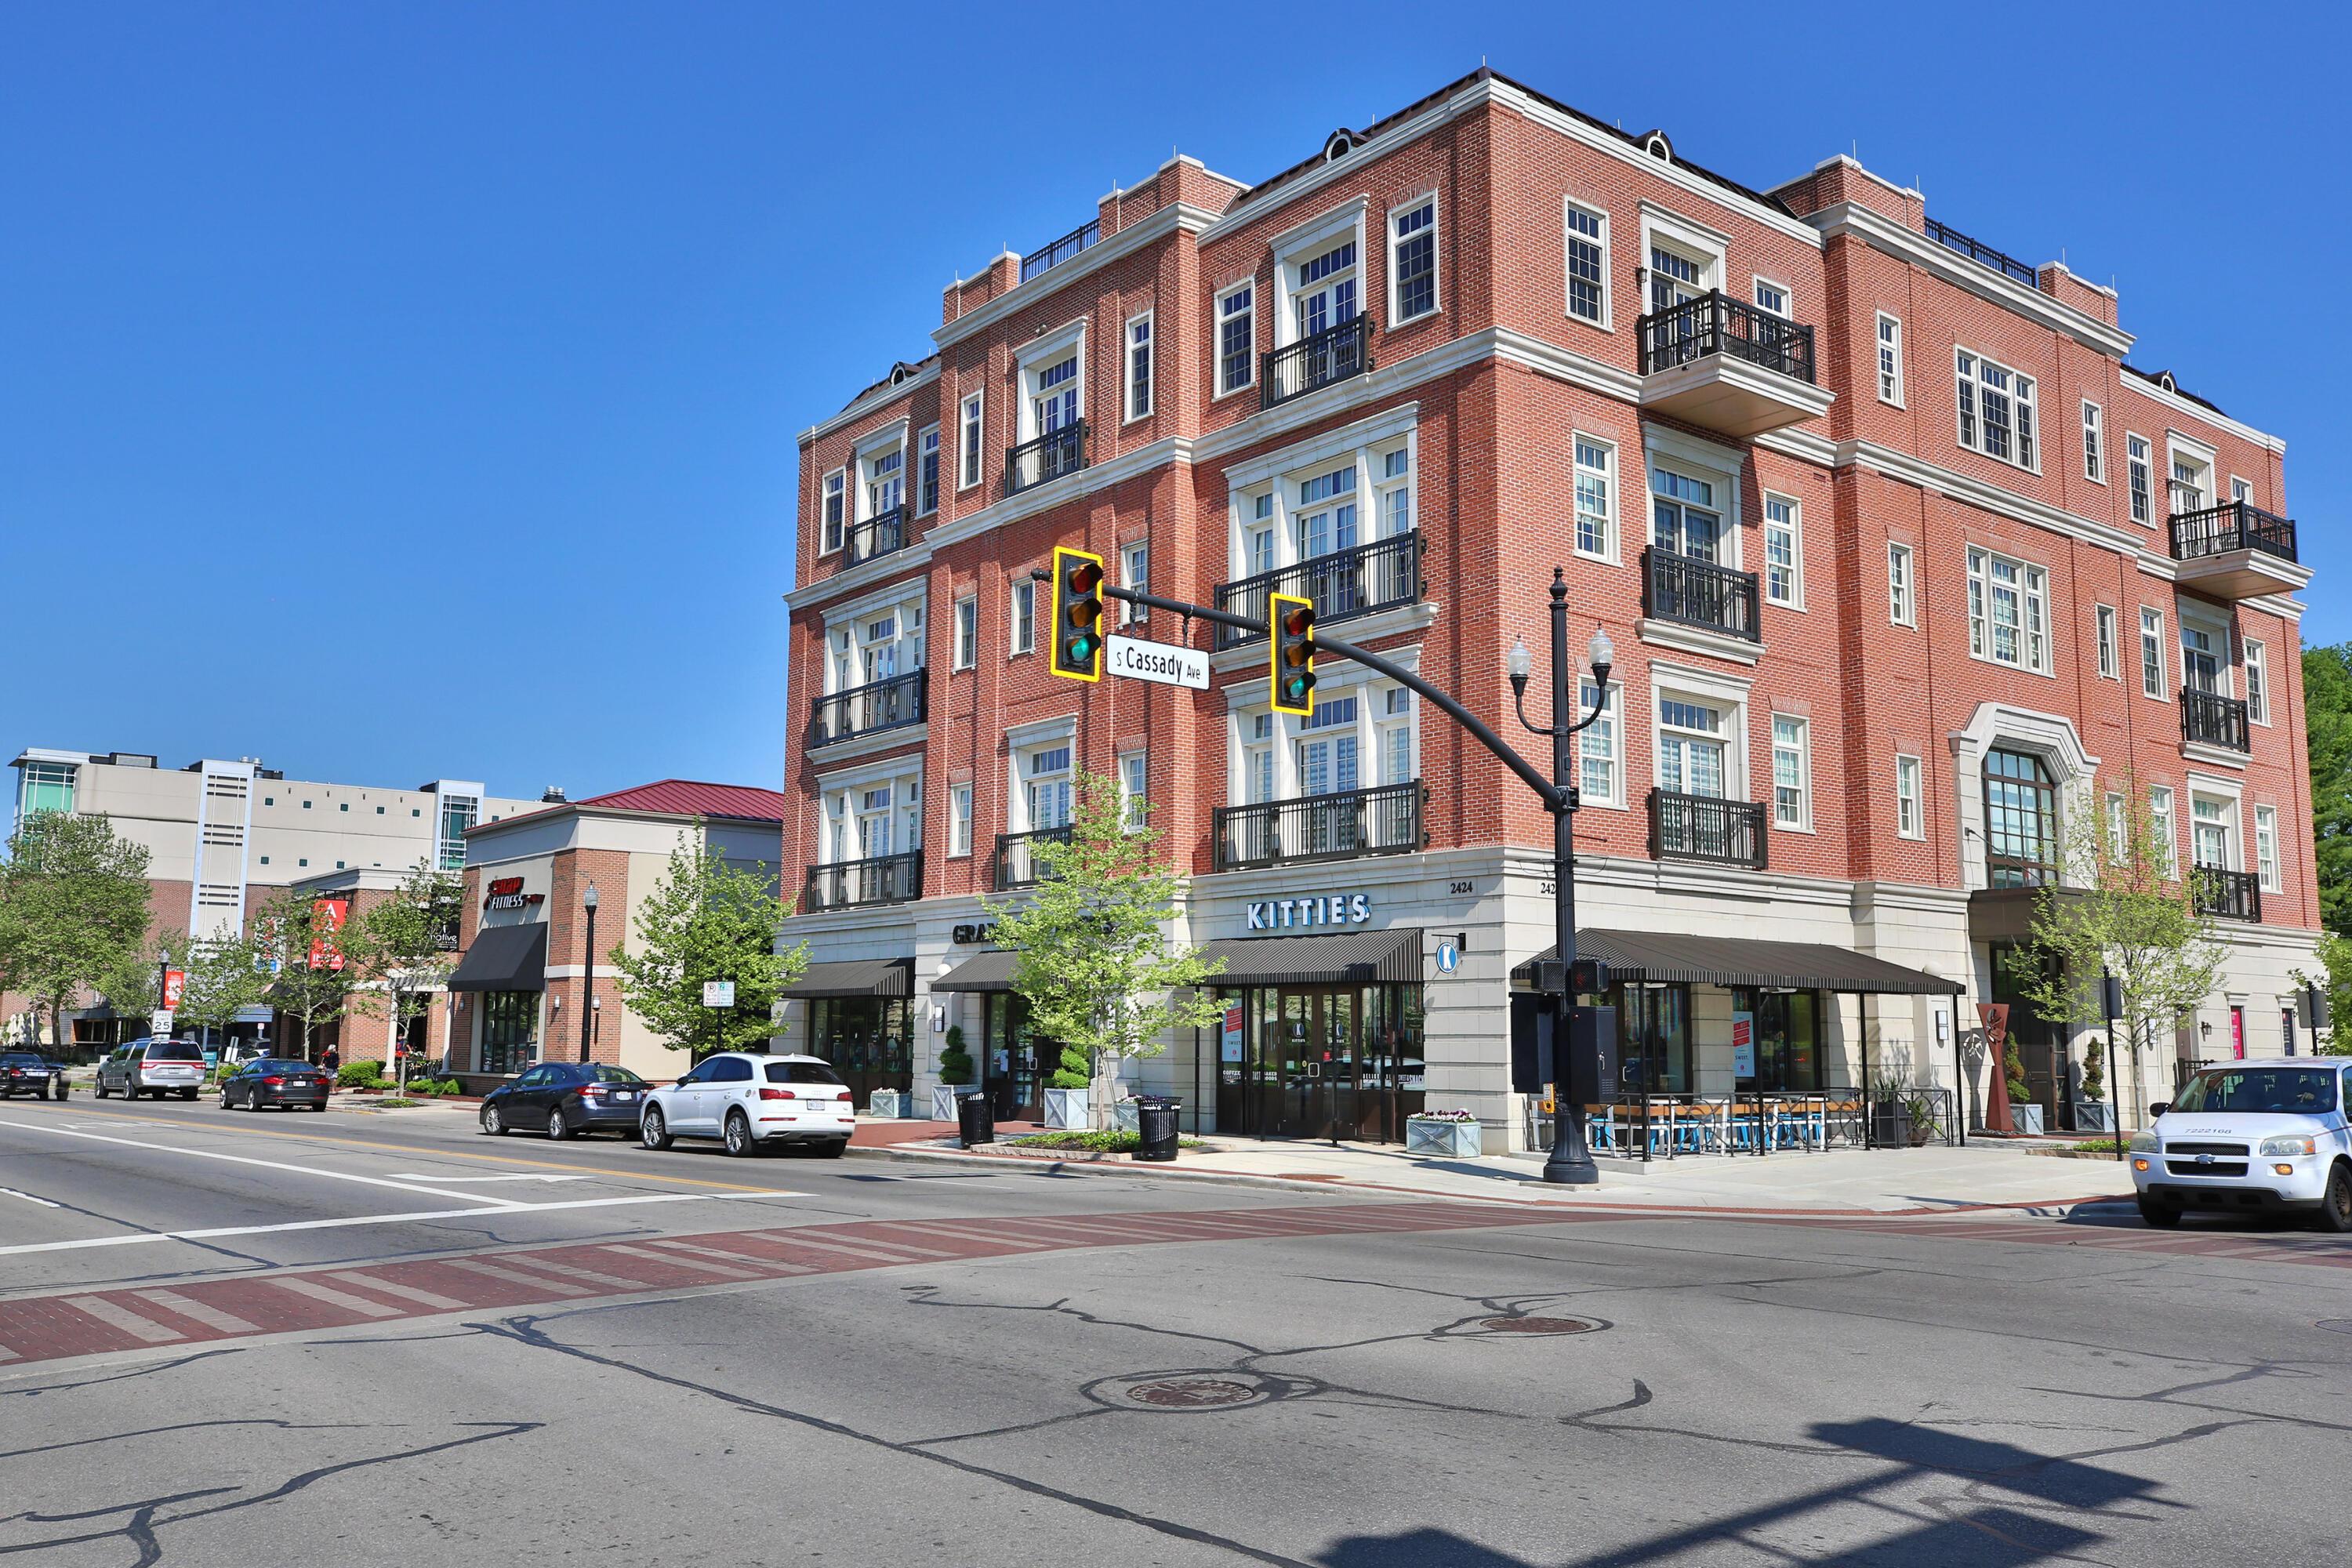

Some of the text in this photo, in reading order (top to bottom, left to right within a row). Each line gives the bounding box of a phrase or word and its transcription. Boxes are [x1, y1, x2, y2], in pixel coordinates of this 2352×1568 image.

[1116, 646, 1200, 683] S Cassady Ave
[1450, 881, 1473, 894] 2424
[1541, 882, 1556, 895] 242
[492, 895, 524, 909] FITNESS
[1443, 946, 1452, 969] K
[154, 1022, 170, 1030] 25
